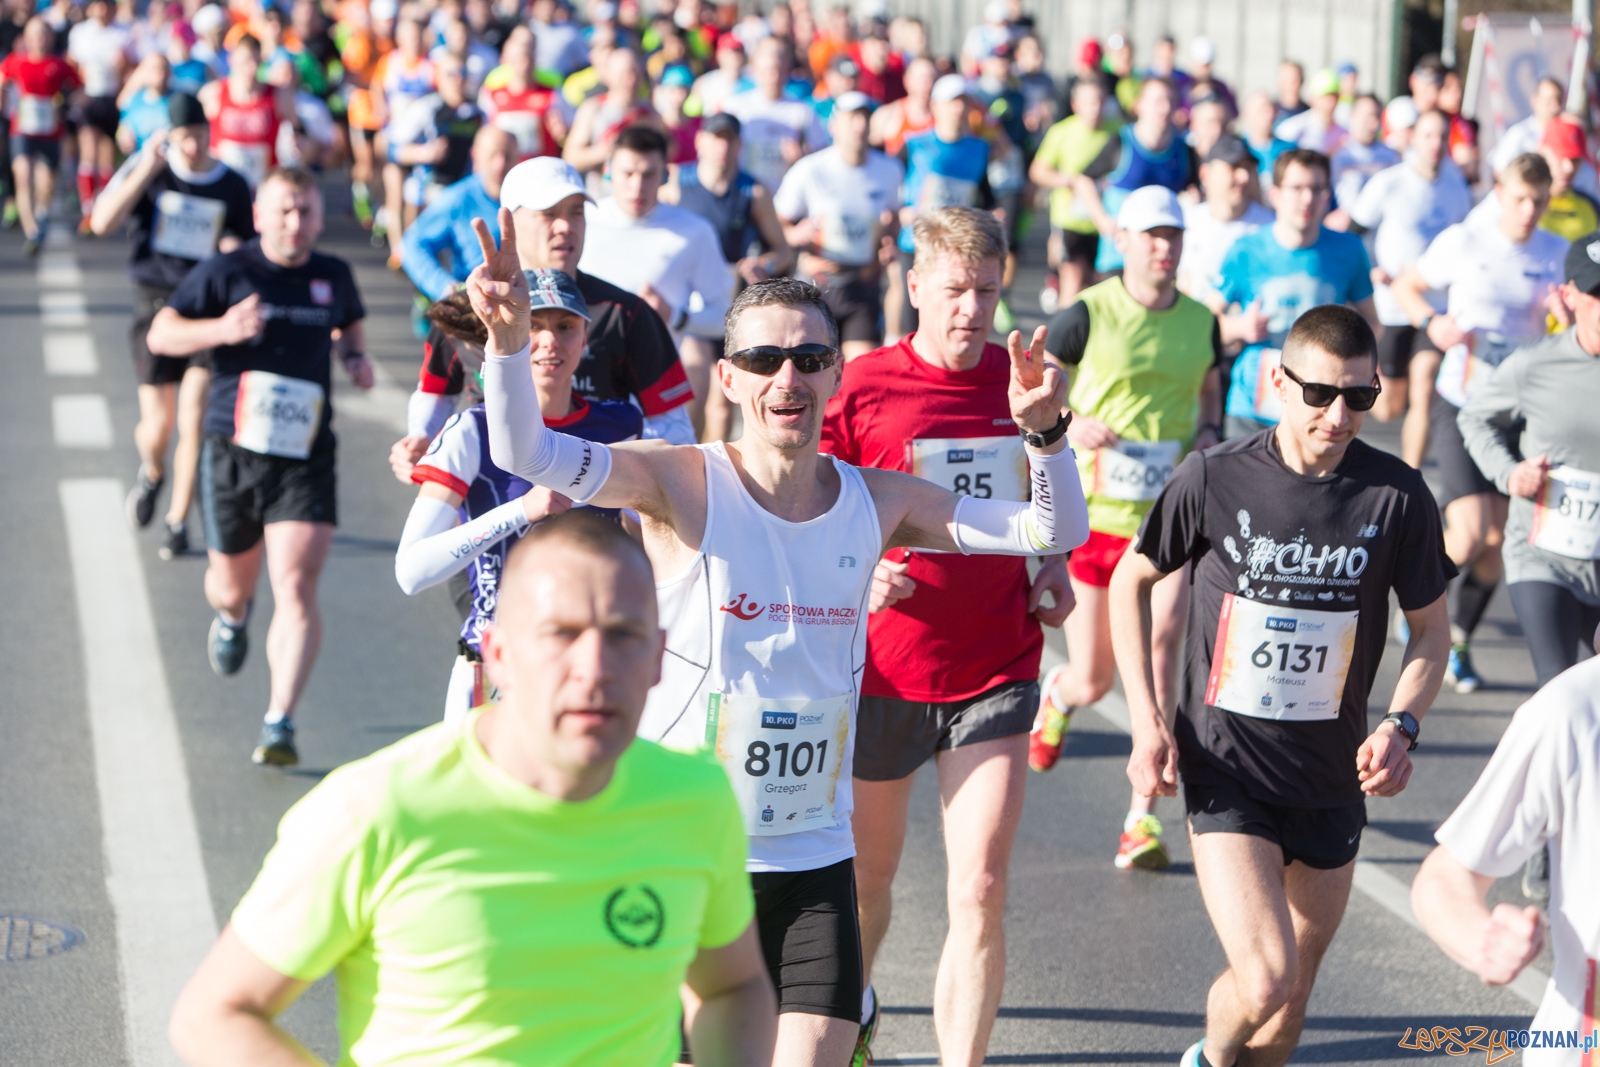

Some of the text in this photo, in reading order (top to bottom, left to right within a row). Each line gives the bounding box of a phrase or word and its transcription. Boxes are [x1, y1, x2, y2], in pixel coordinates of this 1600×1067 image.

[953, 473, 992, 499] 85
[1250, 541, 1369, 578] #CH10
[805, 617, 831, 626] GRUPA
[1278, 621, 1295, 630] PKO
[1251, 641, 1329, 674] 6131
[1266, 675, 1307, 687] Mateusz
[765, 715, 777, 725] 10.
[777, 716, 795, 726] PKO
[744, 739, 829, 778] 8101
[764, 783, 808, 795] Grzegorz
